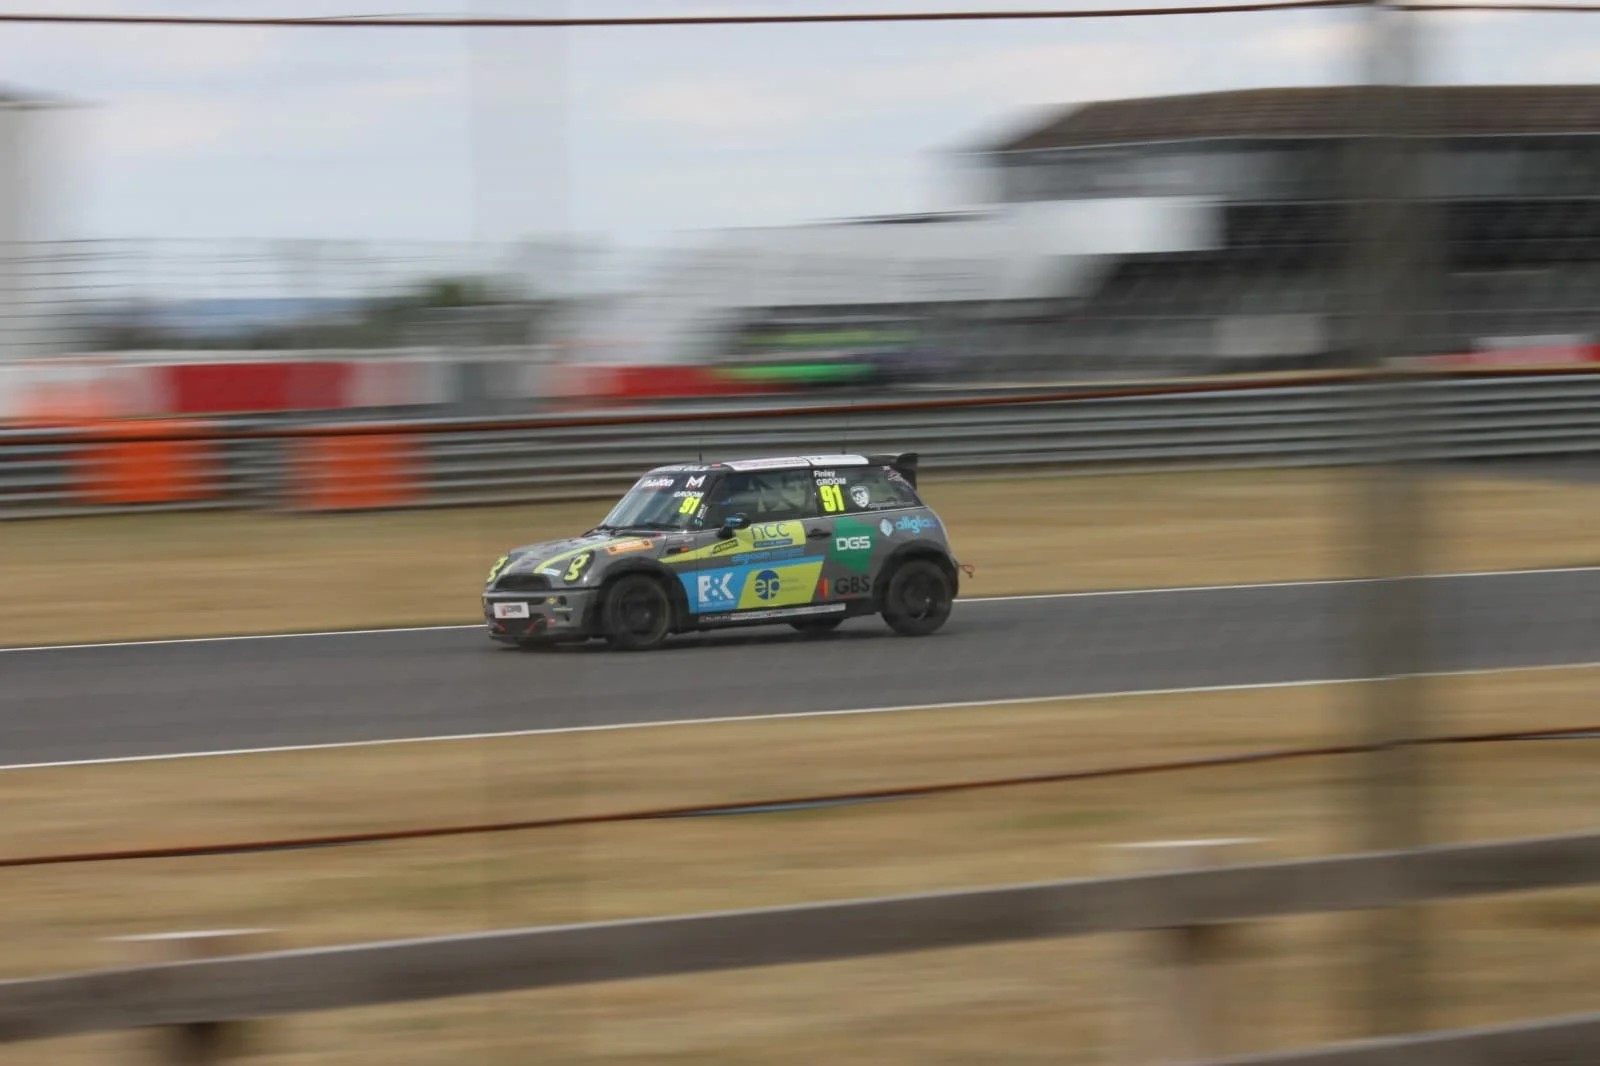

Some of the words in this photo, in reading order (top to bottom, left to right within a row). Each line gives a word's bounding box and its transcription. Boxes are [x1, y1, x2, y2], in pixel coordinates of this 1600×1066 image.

[816, 478, 846, 486] GROOM
[679, 496, 701, 514] 91
[820, 485, 845, 512] 91
[836, 536, 871, 551] DGS
[835, 575, 871, 595] GBS
